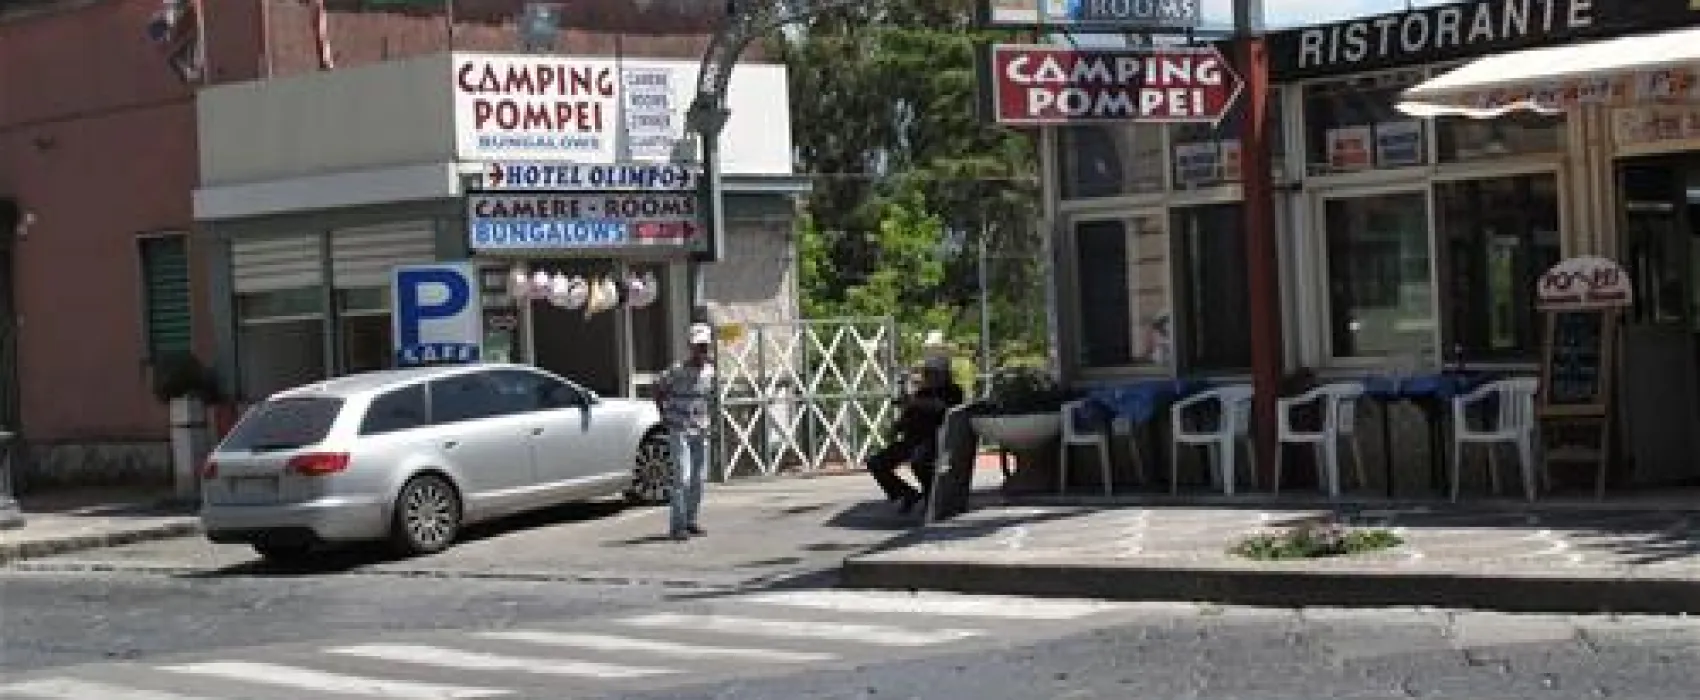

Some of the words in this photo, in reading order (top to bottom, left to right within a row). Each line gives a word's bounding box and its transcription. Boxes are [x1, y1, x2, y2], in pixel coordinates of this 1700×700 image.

[1299, 0, 1594, 67] RISTORANTE
[458, 62, 614, 96] CAMPING
[1004, 55, 1223, 86] CAMPING
[473, 98, 604, 132] POMPEI
[1026, 87, 1206, 117] POMPEI
[507, 165, 581, 186] HOTEL
[589, 165, 676, 187] OLIMPO
[474, 200, 582, 219] CAMERE
[604, 198, 696, 219] ROOMS
[474, 220, 625, 243] BUNGALOWS
[397, 270, 471, 346] P
